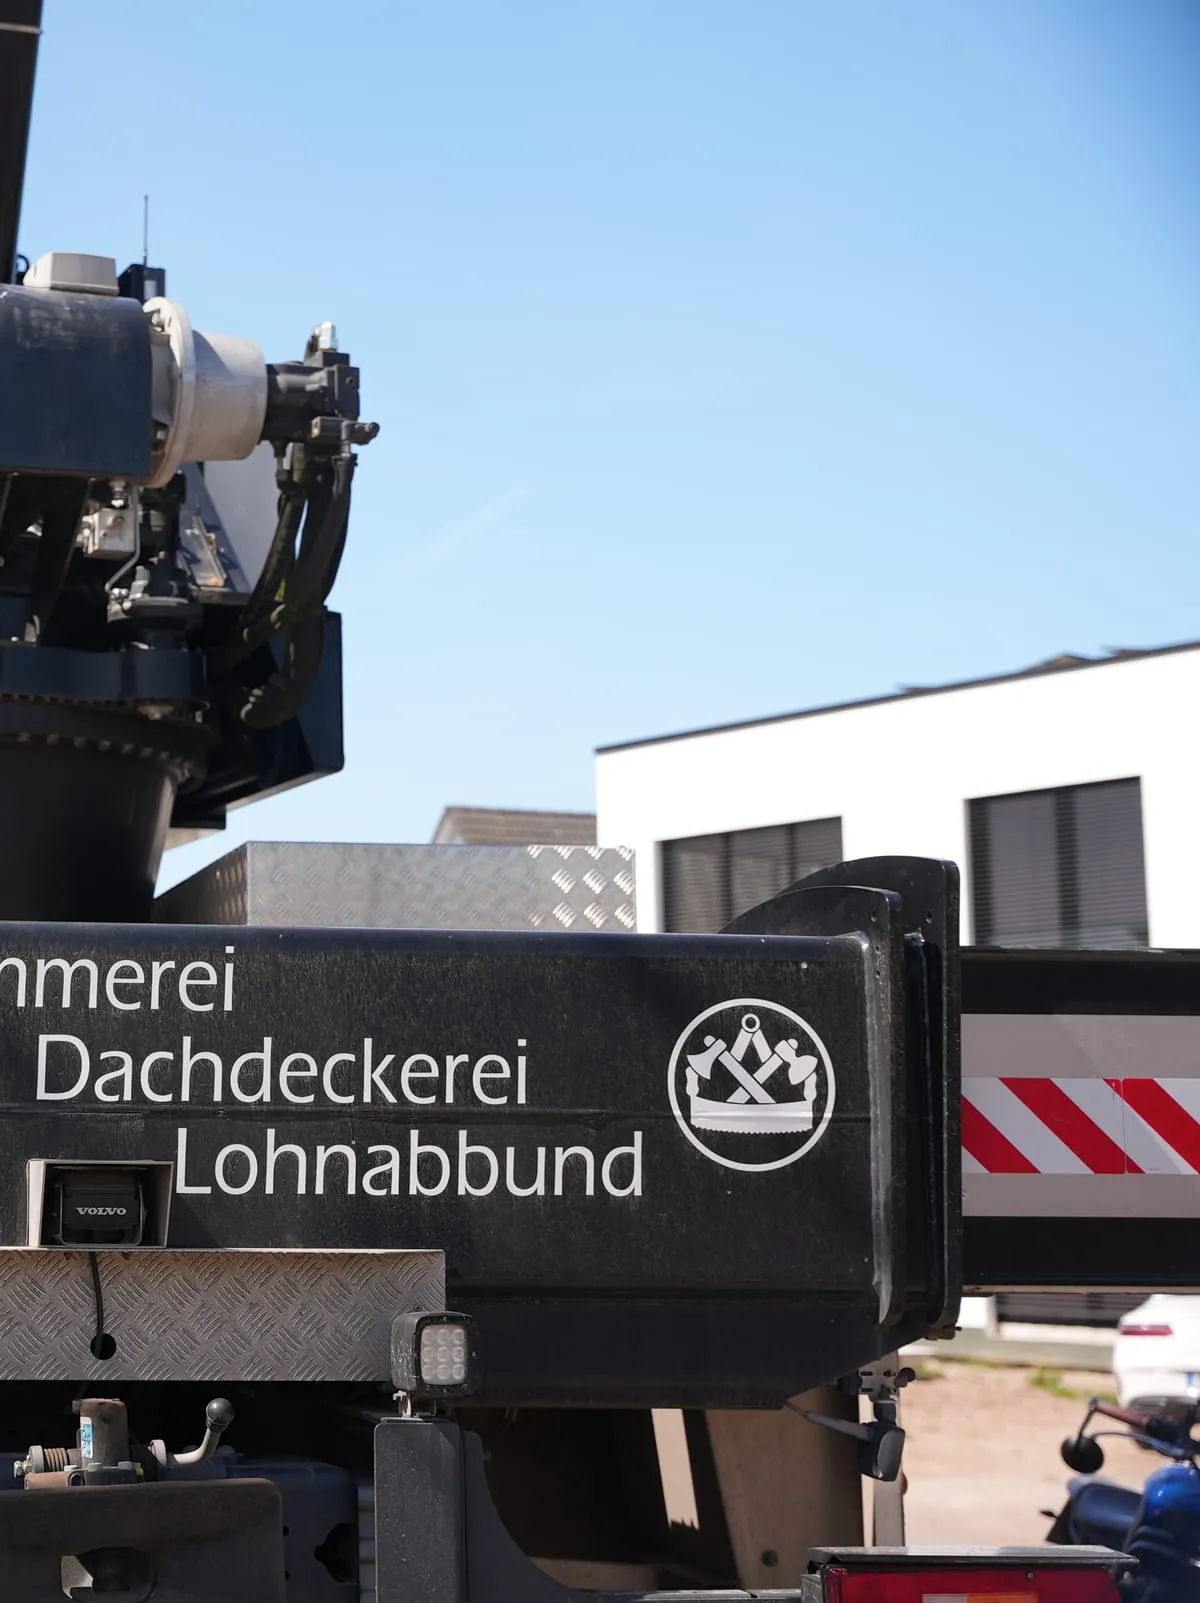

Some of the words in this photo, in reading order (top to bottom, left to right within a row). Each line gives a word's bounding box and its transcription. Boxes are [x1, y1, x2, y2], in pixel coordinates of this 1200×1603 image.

[36, 1034, 527, 1105] Dachdeckerei
[176, 1127, 643, 1197] Lohnabbund
[76, 1207, 127, 1216] VOLVO
